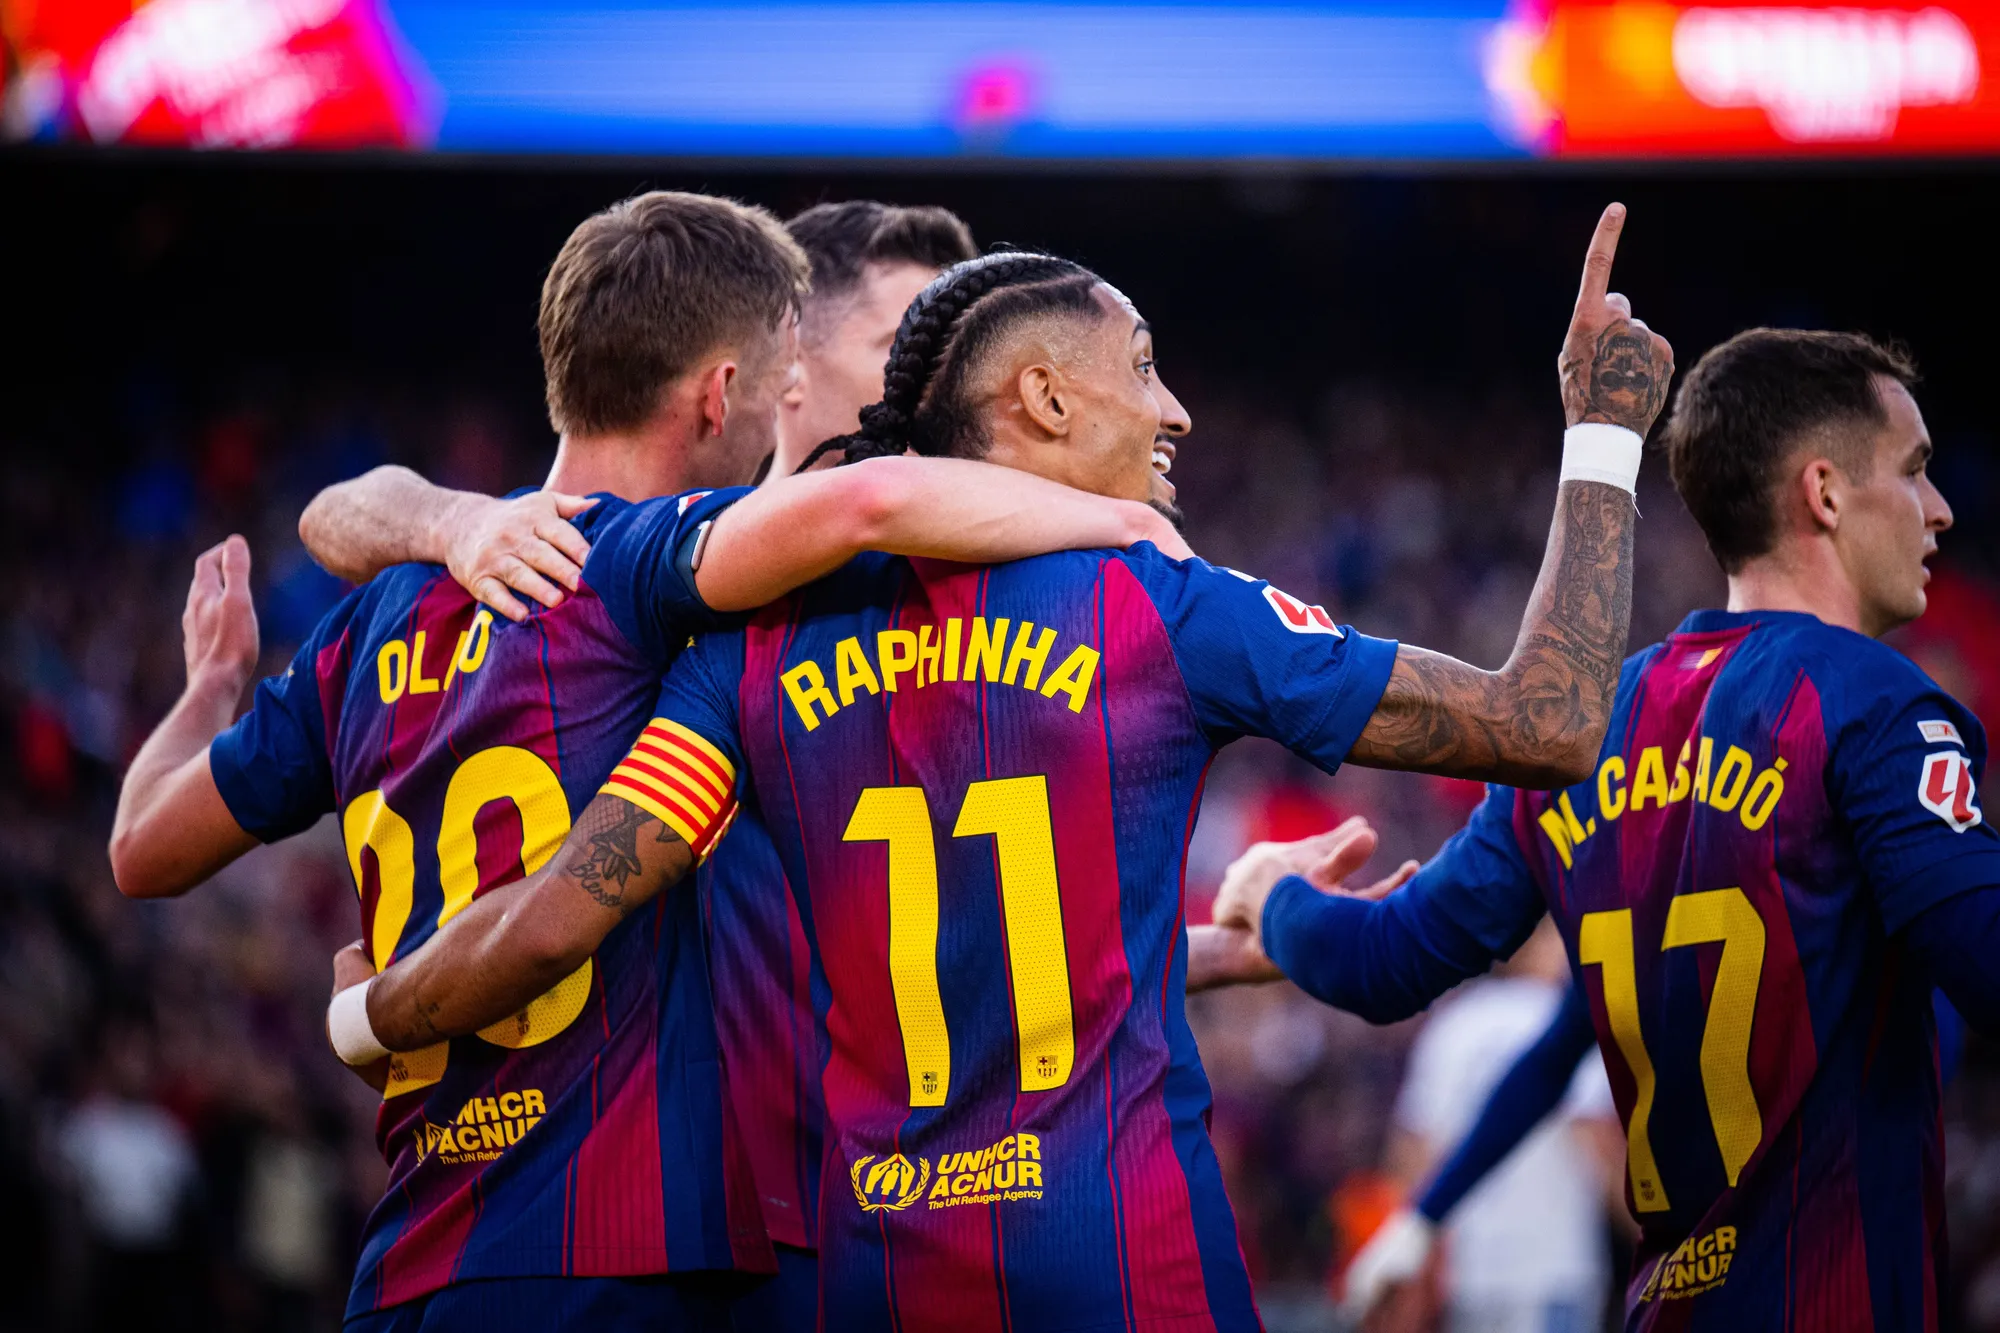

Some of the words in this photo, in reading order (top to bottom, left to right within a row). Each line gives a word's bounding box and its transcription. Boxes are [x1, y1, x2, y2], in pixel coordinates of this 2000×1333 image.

[780, 616, 1101, 732] RAPHINHA
[842, 774, 1075, 1107] 11
[1580, 887, 1766, 1213] 17
[449, 1088, 547, 1126] NHCR
[460, 1153, 476, 1163] UN
[477, 1151, 504, 1161] Refu
[937, 1132, 1042, 1175] UNHCR
[927, 1160, 1043, 1200] ACNUR
[928, 1201, 944, 1210] The
[945, 1196, 960, 1207] UN
[961, 1192, 1002, 1205] Refugee
[1003, 1189, 1043, 1202] Agency
